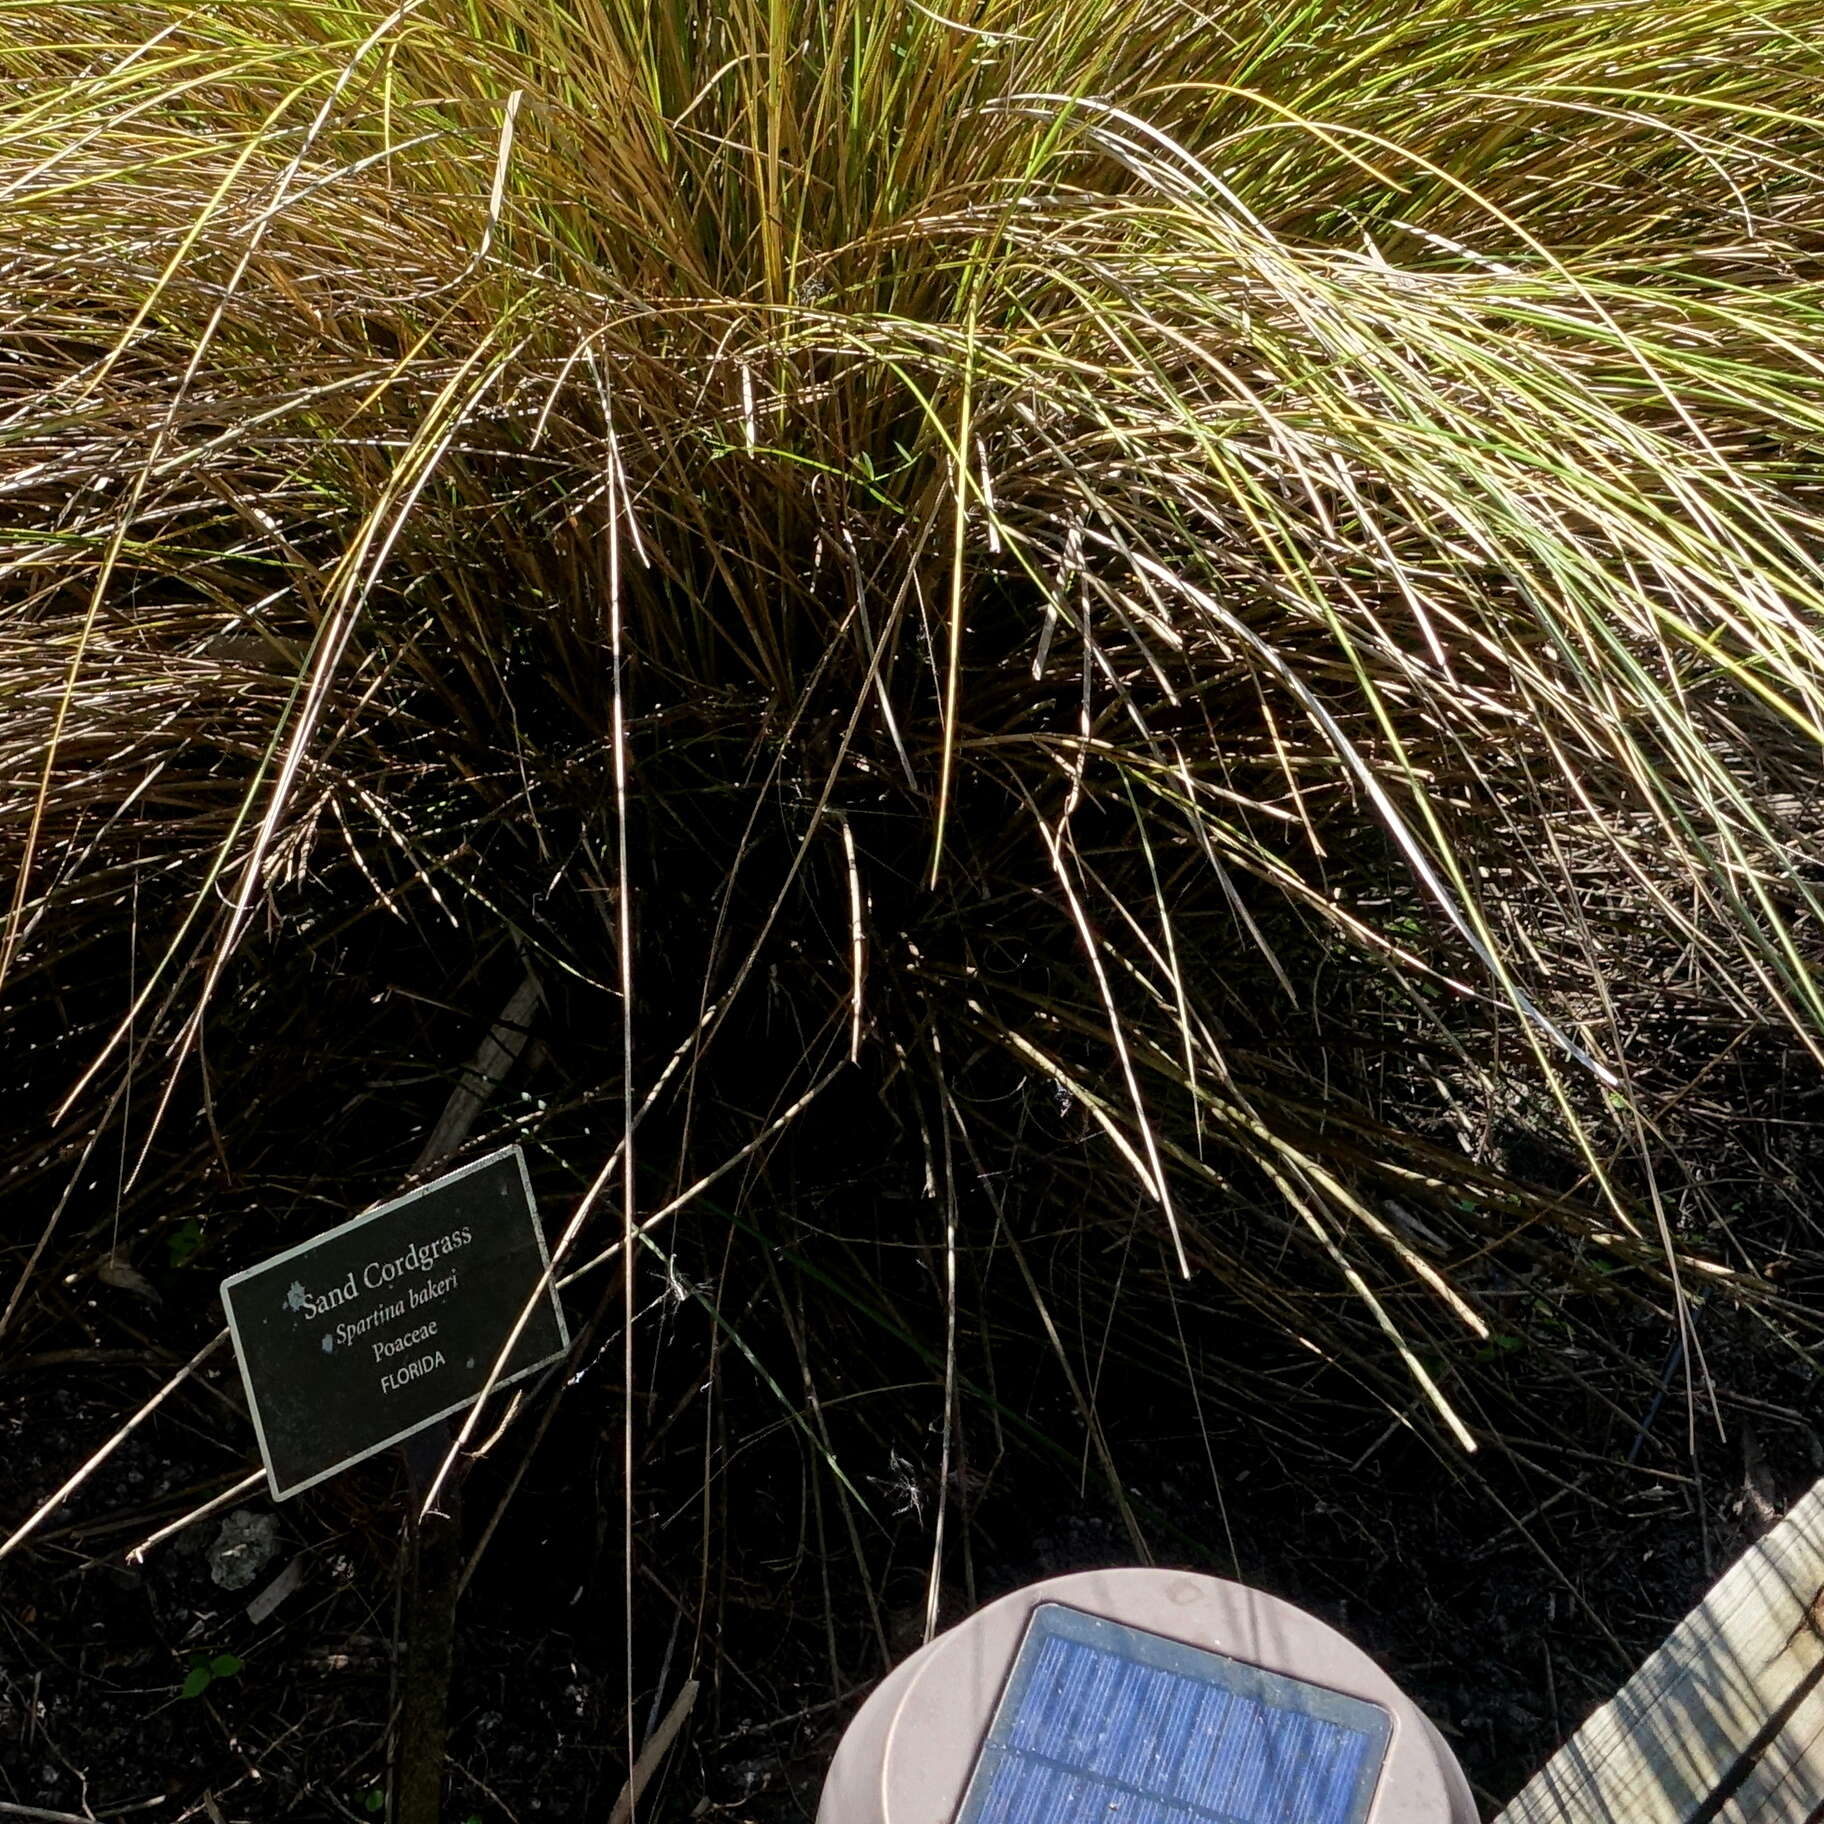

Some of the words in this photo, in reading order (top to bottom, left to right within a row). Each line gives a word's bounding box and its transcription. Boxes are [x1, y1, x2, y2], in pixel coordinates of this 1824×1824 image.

[302, 1272, 359, 1319] Sand
[363, 1226, 472, 1288] Cordgrass
[336, 1299, 405, 1346] Spartina
[409, 1269, 459, 1308] bakeri
[372, 1319, 439, 1363] Poaceae
[381, 1351, 446, 1394] FLORIDA
